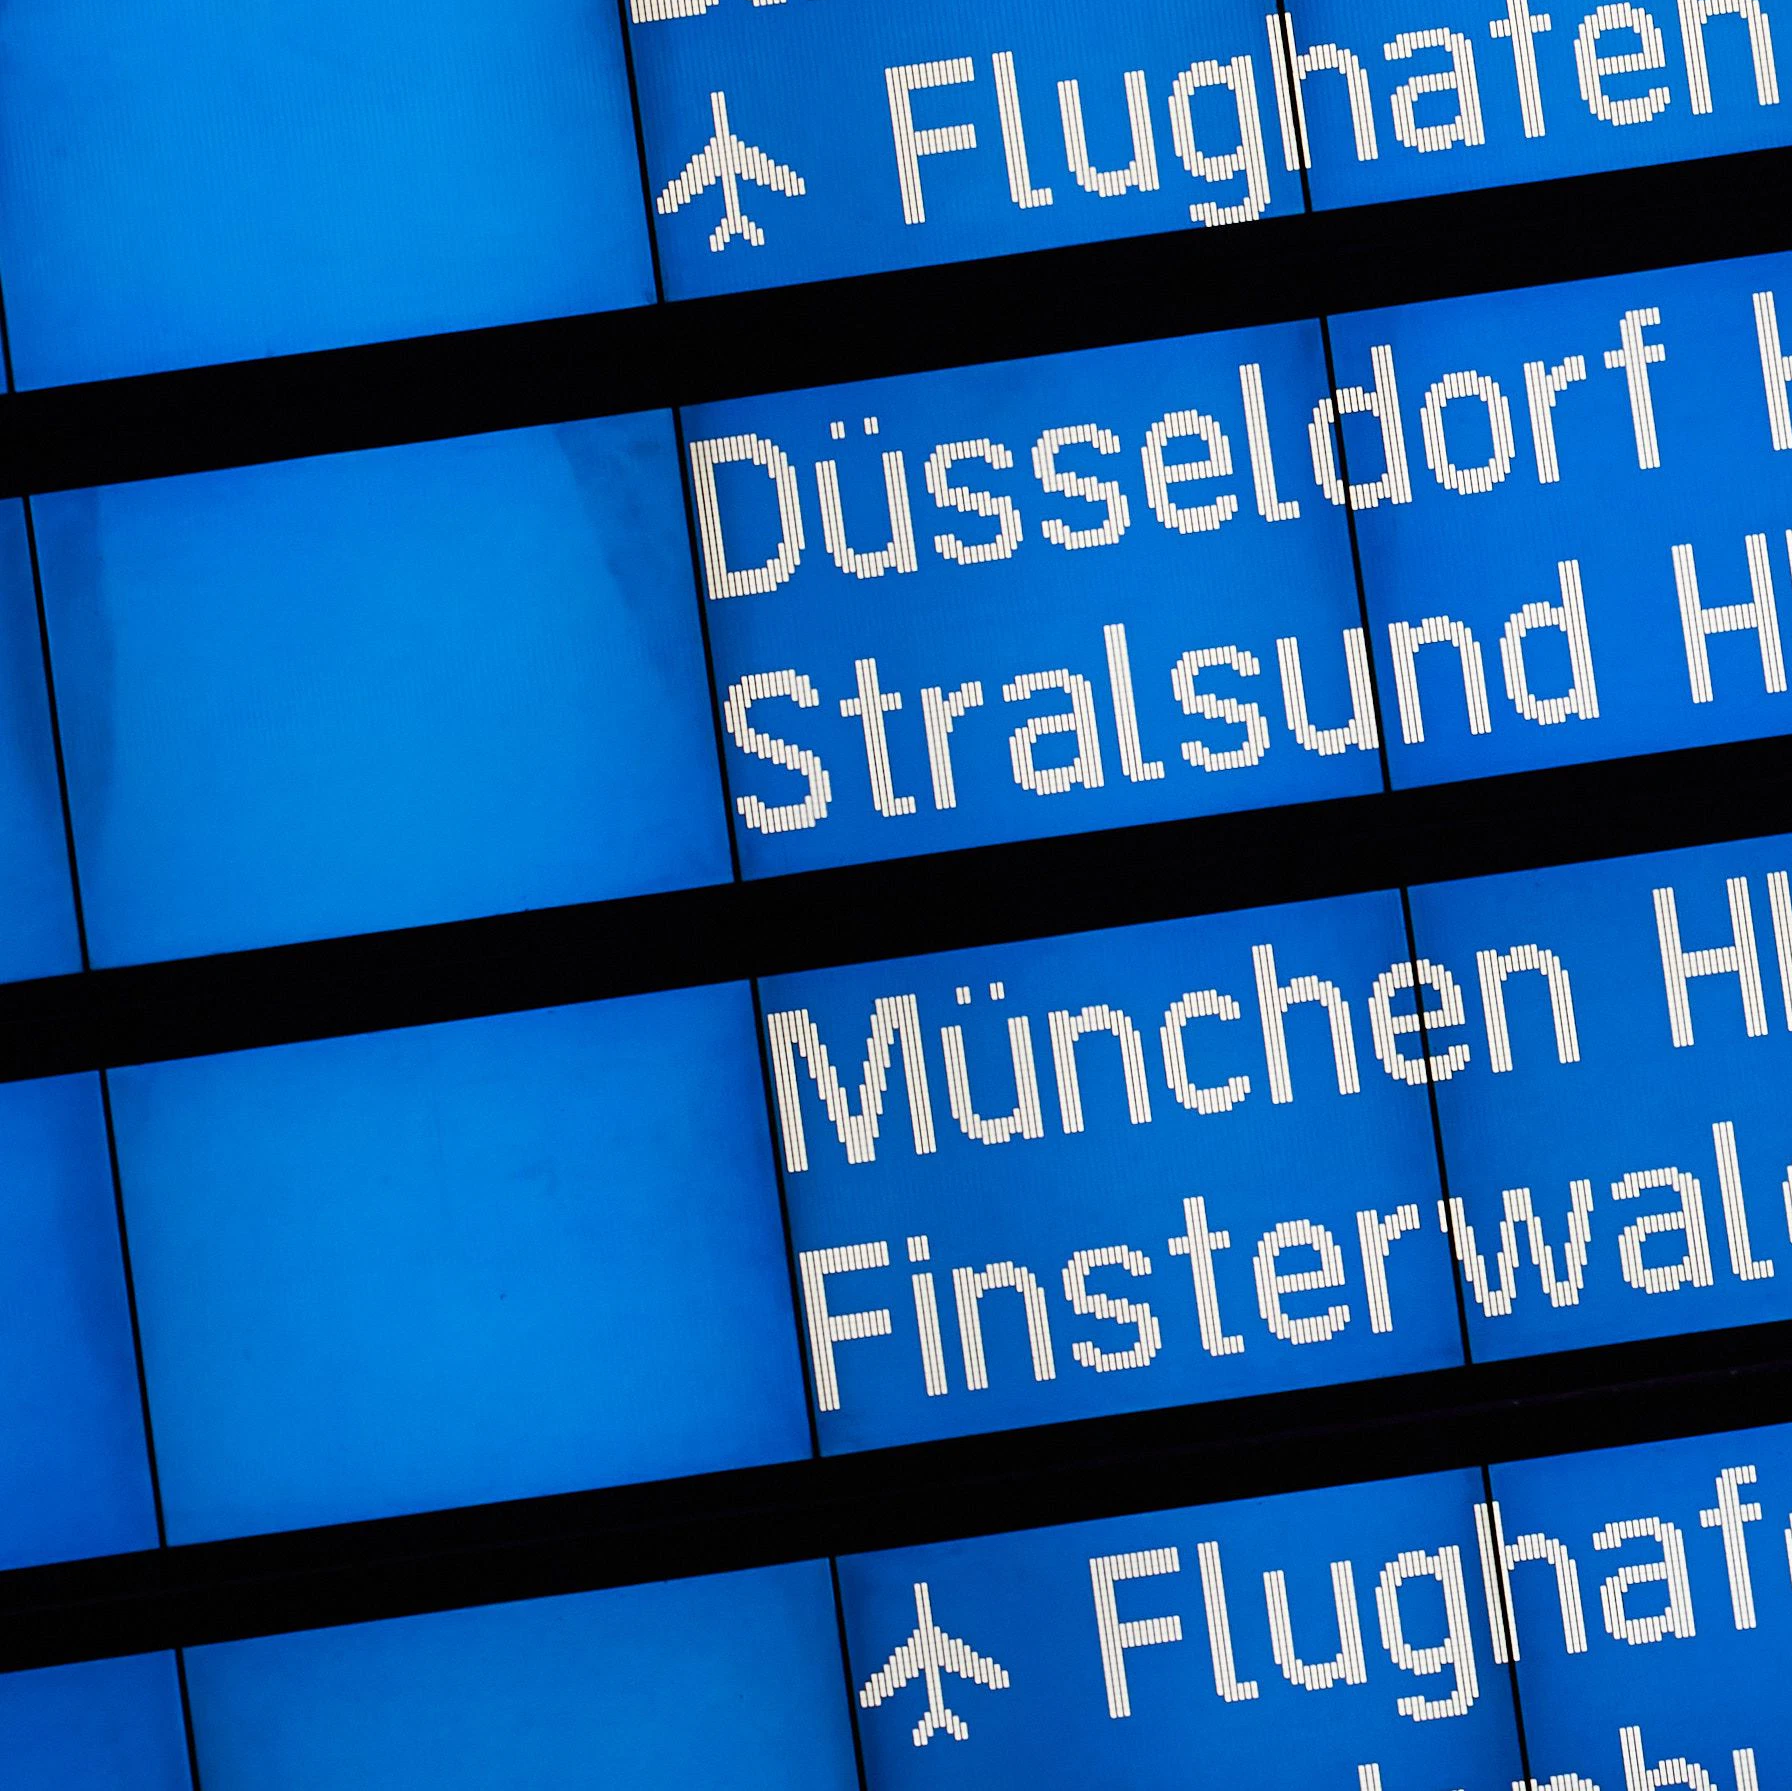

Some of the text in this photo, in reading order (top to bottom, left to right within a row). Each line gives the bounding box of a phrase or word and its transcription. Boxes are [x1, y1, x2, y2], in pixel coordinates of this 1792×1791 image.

[688, 306, 1667, 602] Düsseldorf
[722, 558, 1601, 836] Stralsund
[766, 942, 1582, 1174] München
